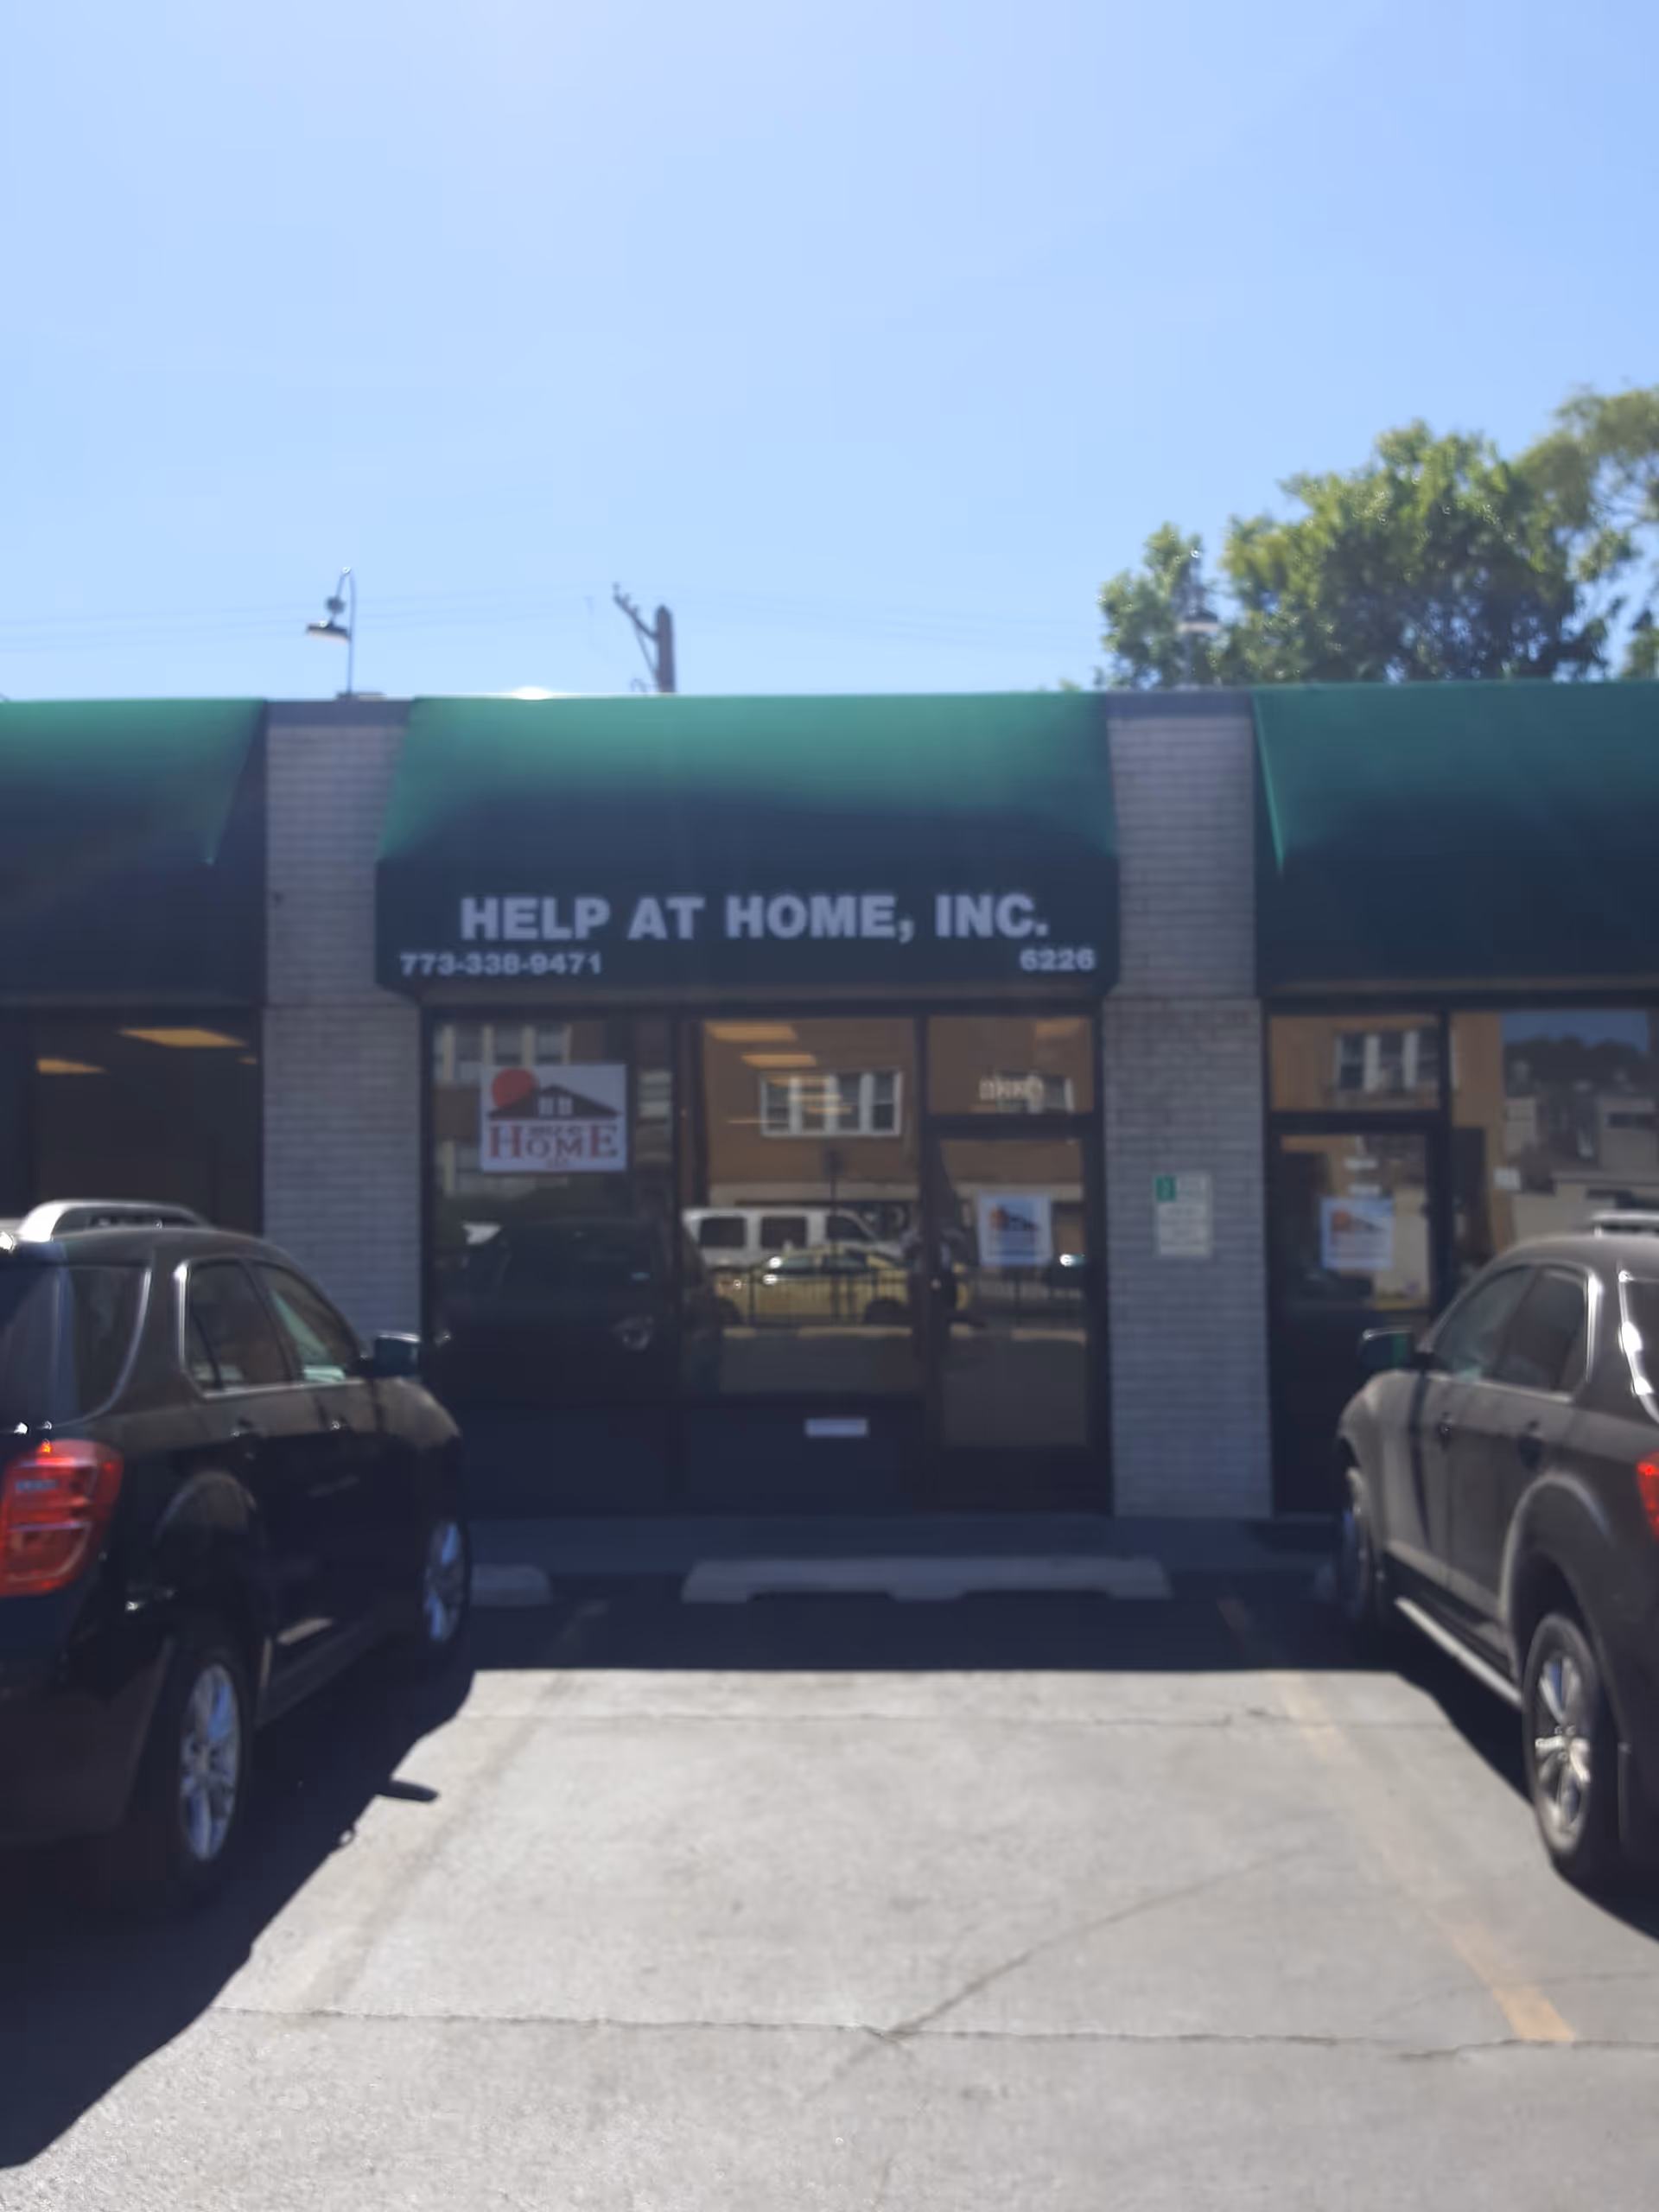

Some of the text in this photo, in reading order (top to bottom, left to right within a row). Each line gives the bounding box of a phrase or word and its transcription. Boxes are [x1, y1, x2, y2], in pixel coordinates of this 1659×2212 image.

[461, 893, 1048, 943] HELP AT HOME, INC.
[400, 951, 602, 976] 773-338-9471
[1019, 947, 1096, 971] 6226
[487, 1123, 618, 1158] HOME
